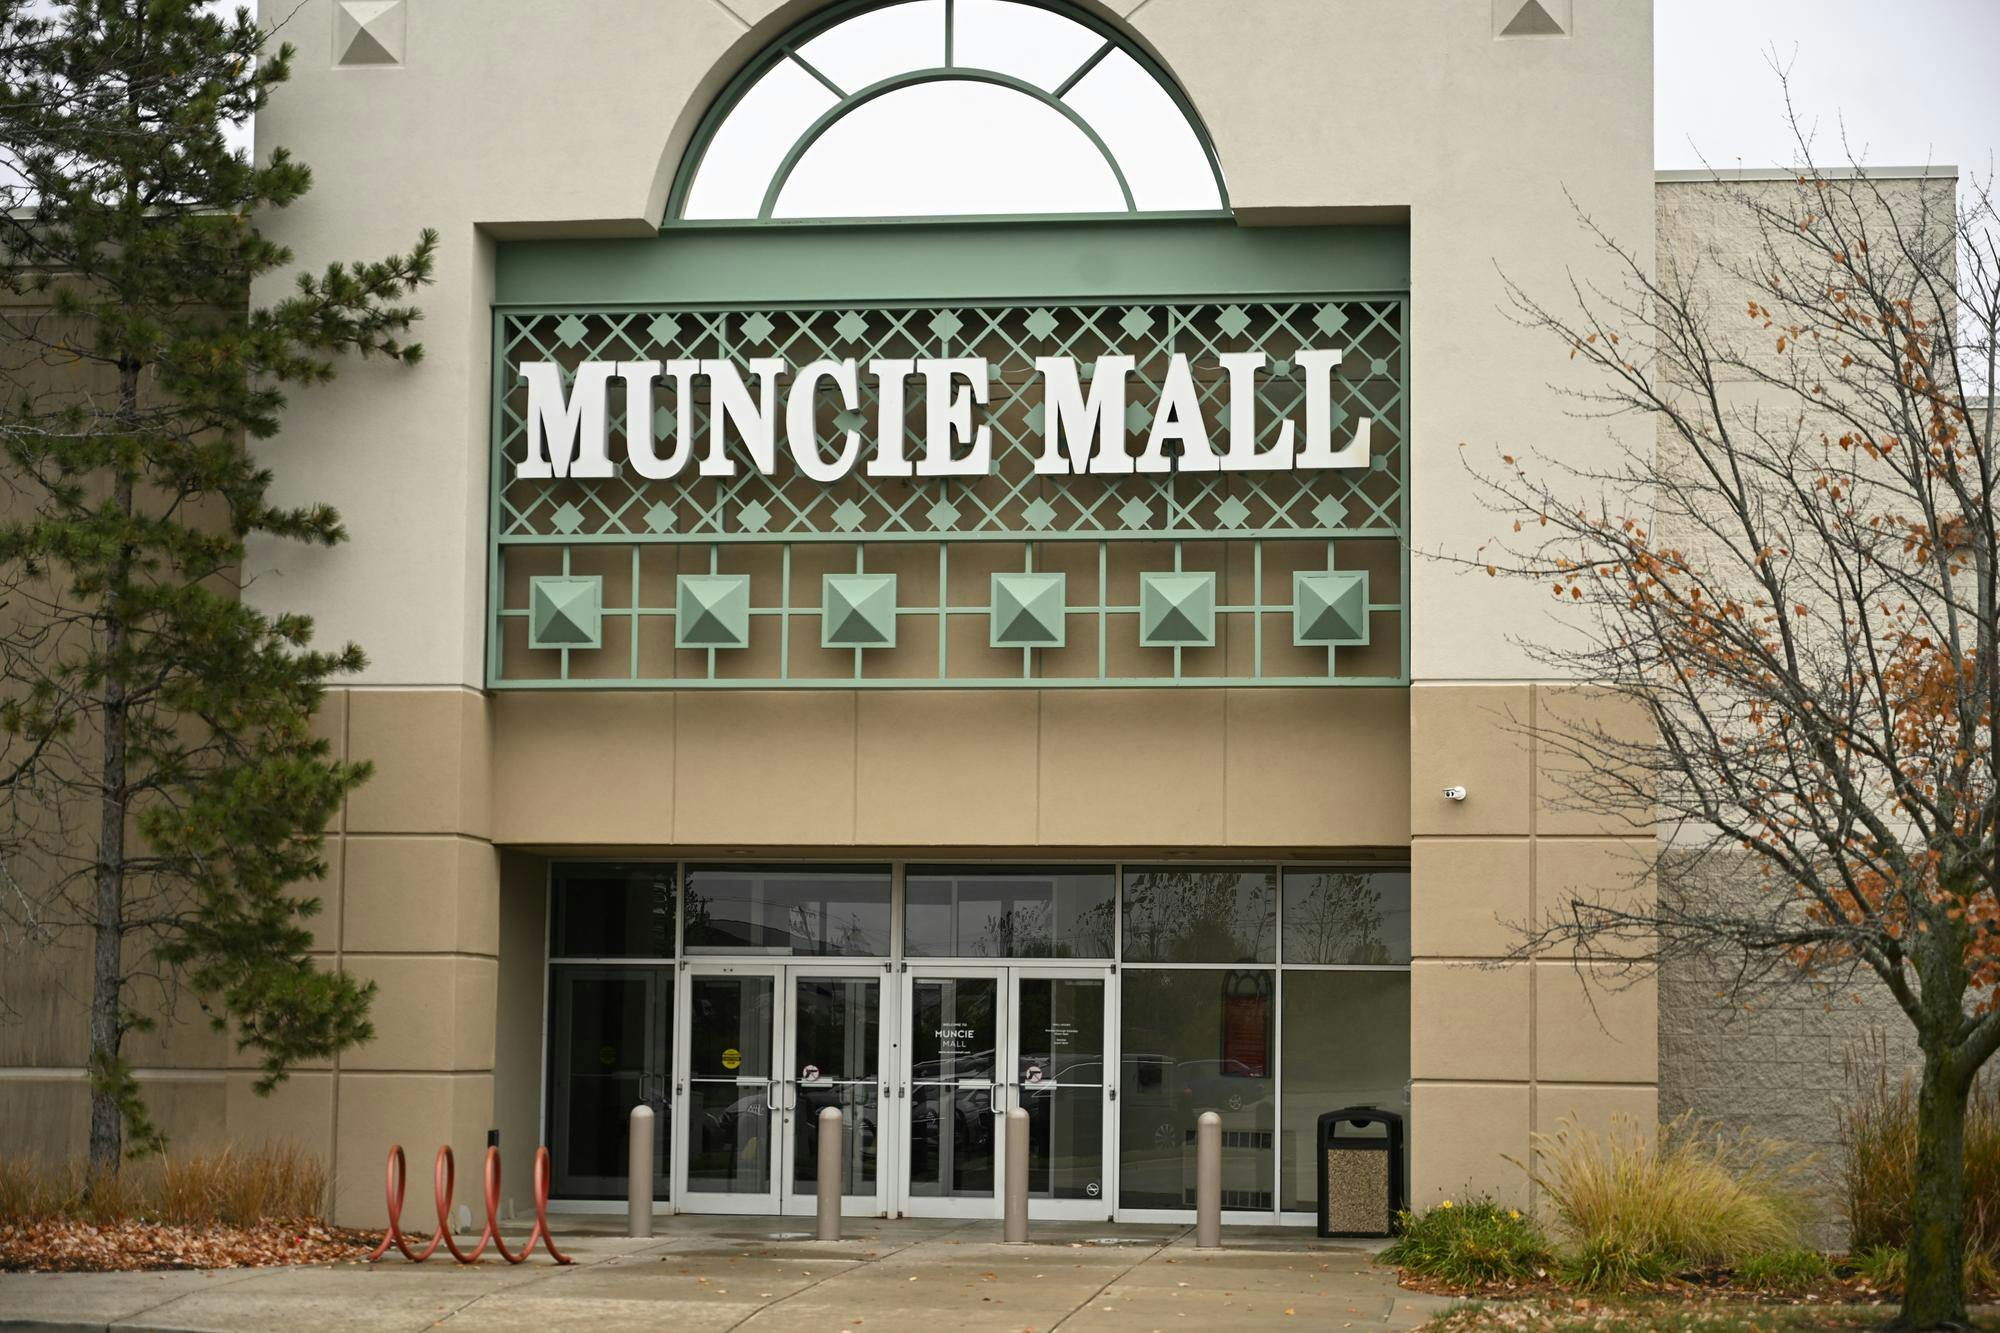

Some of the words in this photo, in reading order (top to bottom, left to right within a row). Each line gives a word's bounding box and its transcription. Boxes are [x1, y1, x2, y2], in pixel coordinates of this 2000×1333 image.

[516, 356, 993, 482] MUNCIE
[1033, 349, 1371, 475] MALL
[935, 1030, 974, 1039] MUNCIE
[942, 1040, 967, 1048] MALL
